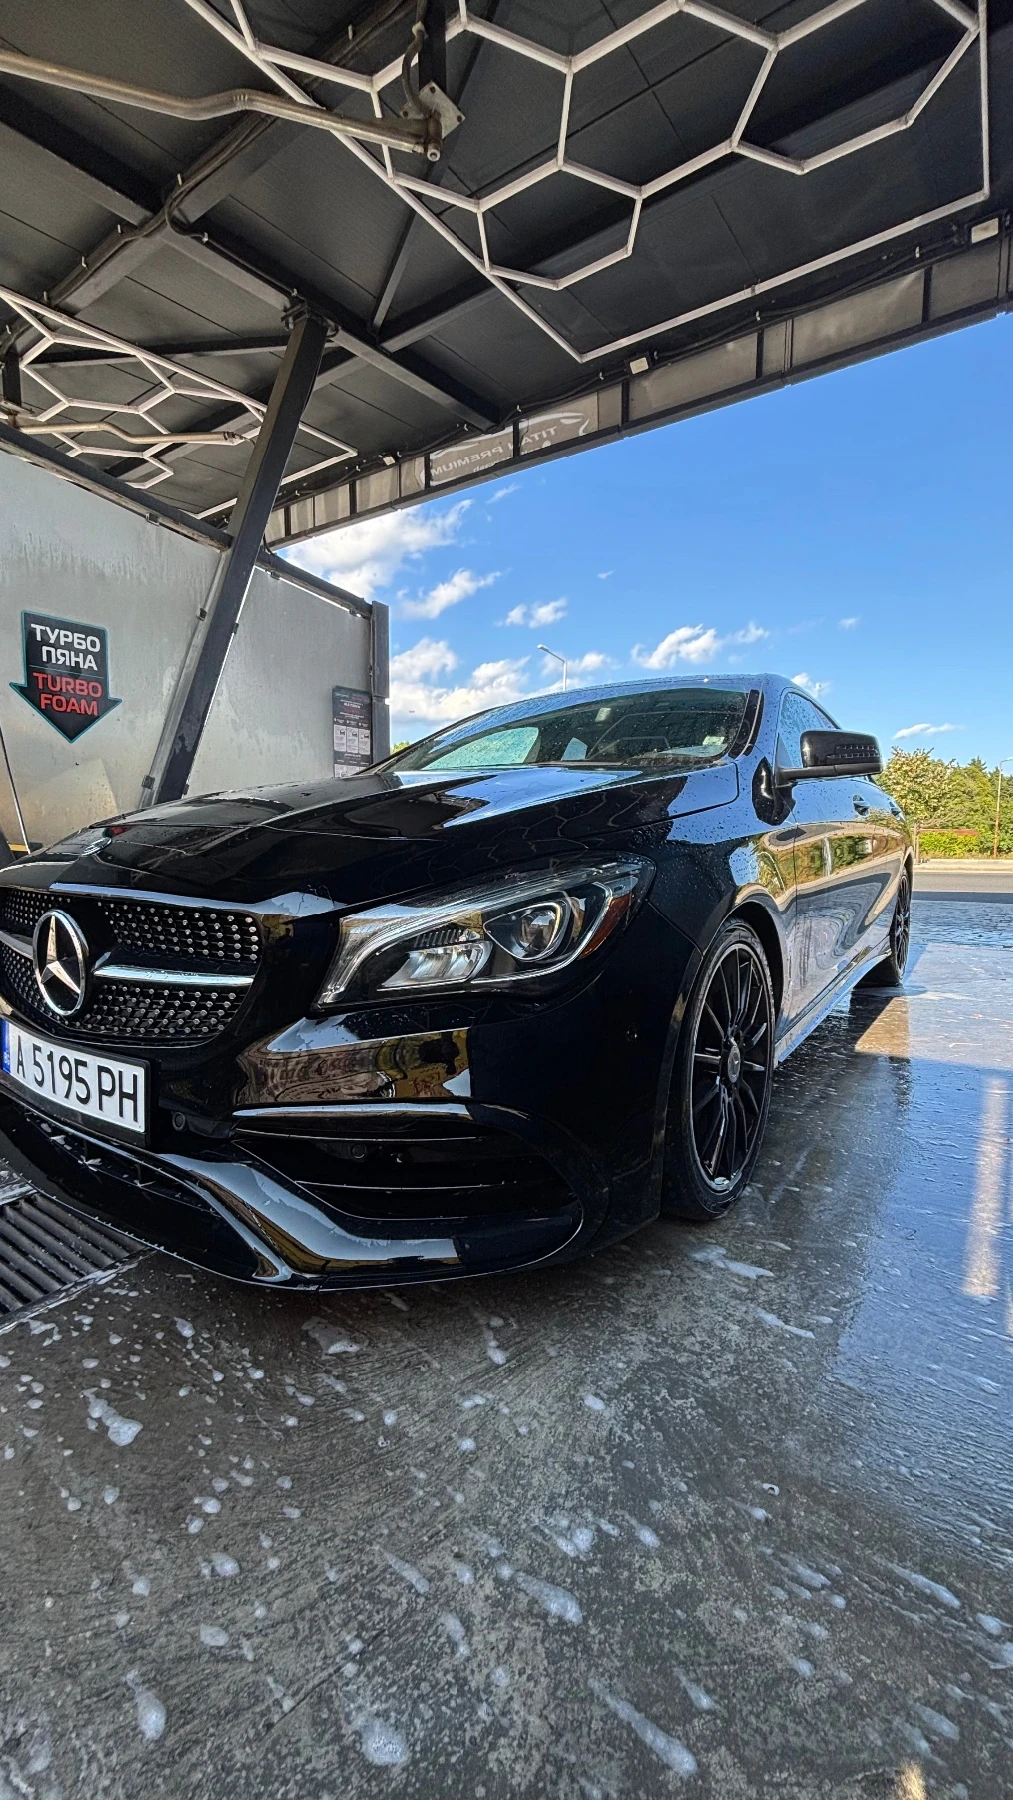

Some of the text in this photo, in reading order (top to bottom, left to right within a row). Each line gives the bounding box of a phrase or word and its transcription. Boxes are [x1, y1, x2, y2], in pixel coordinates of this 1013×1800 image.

[31, 623, 101, 653] ТУРБО
[41, 645, 98, 671] ПЯНА
[33, 672, 102, 698] TURBO
[40, 693, 98, 716] FOAM
[16, 1034, 138, 1122] A 5195 PH
